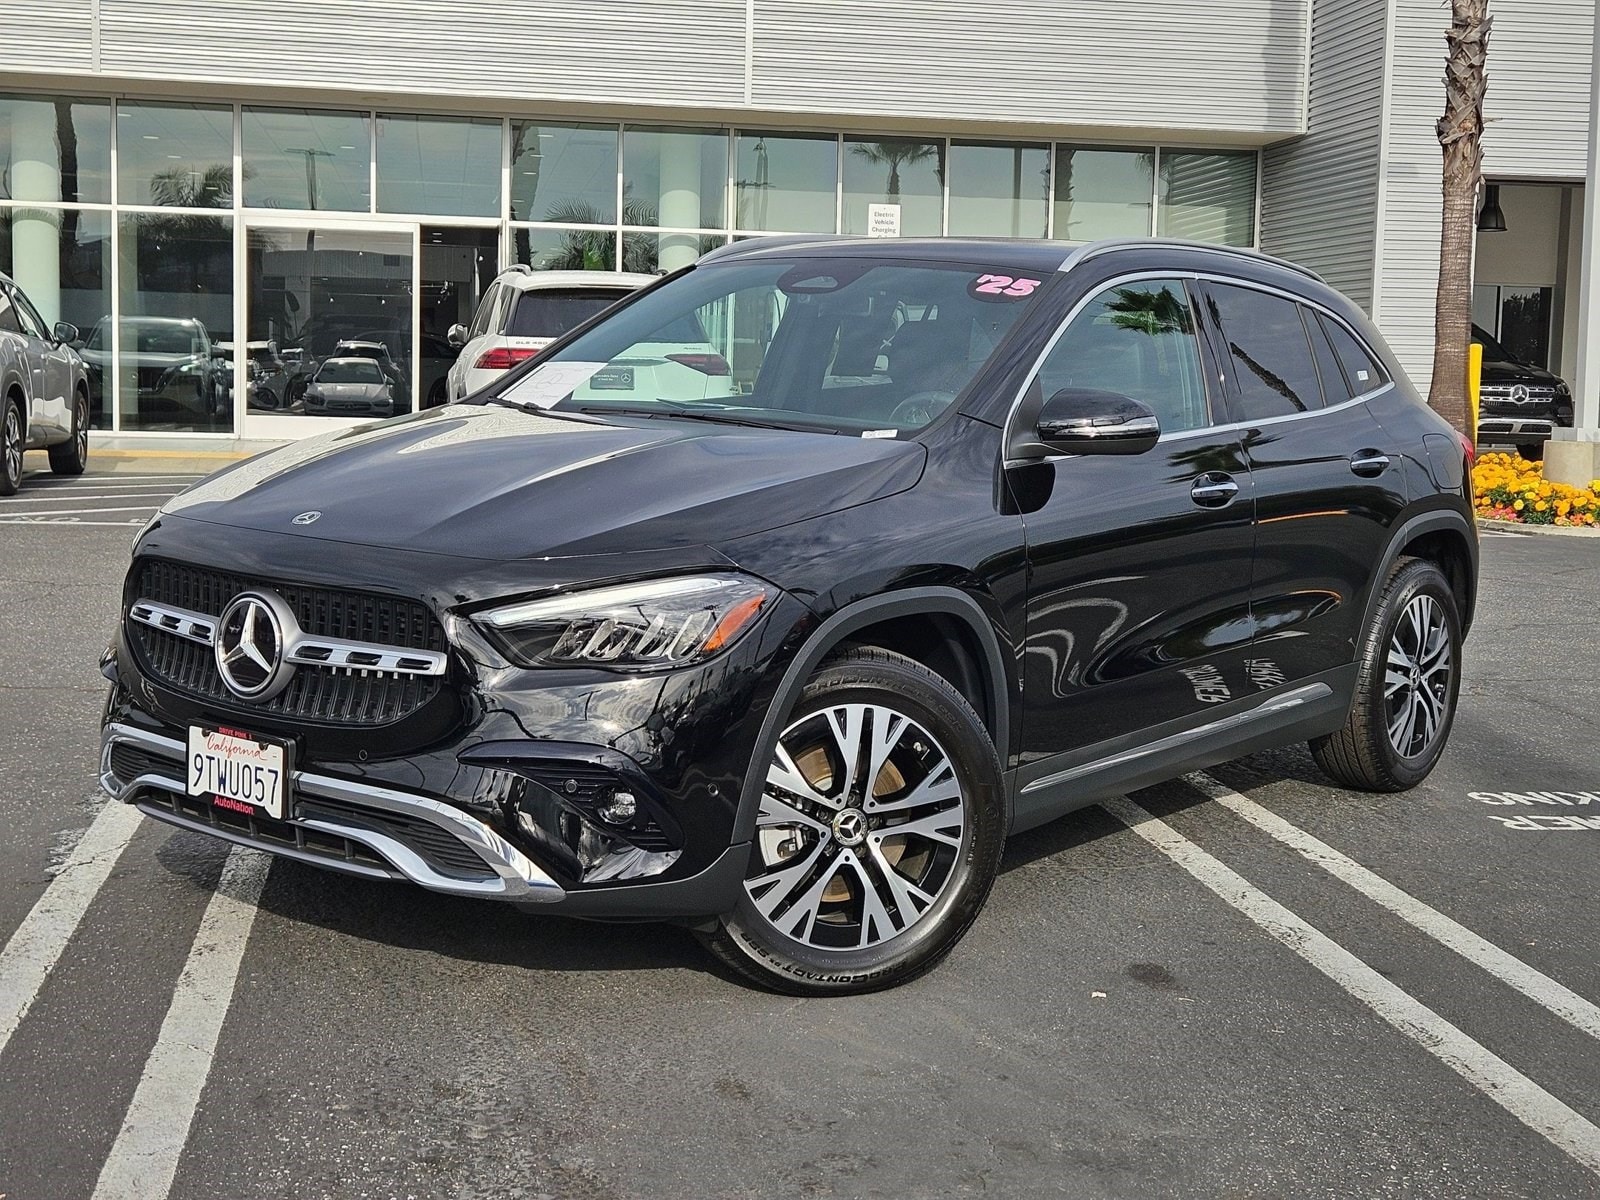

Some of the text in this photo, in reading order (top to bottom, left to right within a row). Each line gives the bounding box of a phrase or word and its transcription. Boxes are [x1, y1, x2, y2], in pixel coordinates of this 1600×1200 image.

[871, 226, 897, 234] Charging
[207, 733, 268, 760] California
[193, 753, 279, 806] 9TWU057
[213, 795, 255, 815] AutoNation
